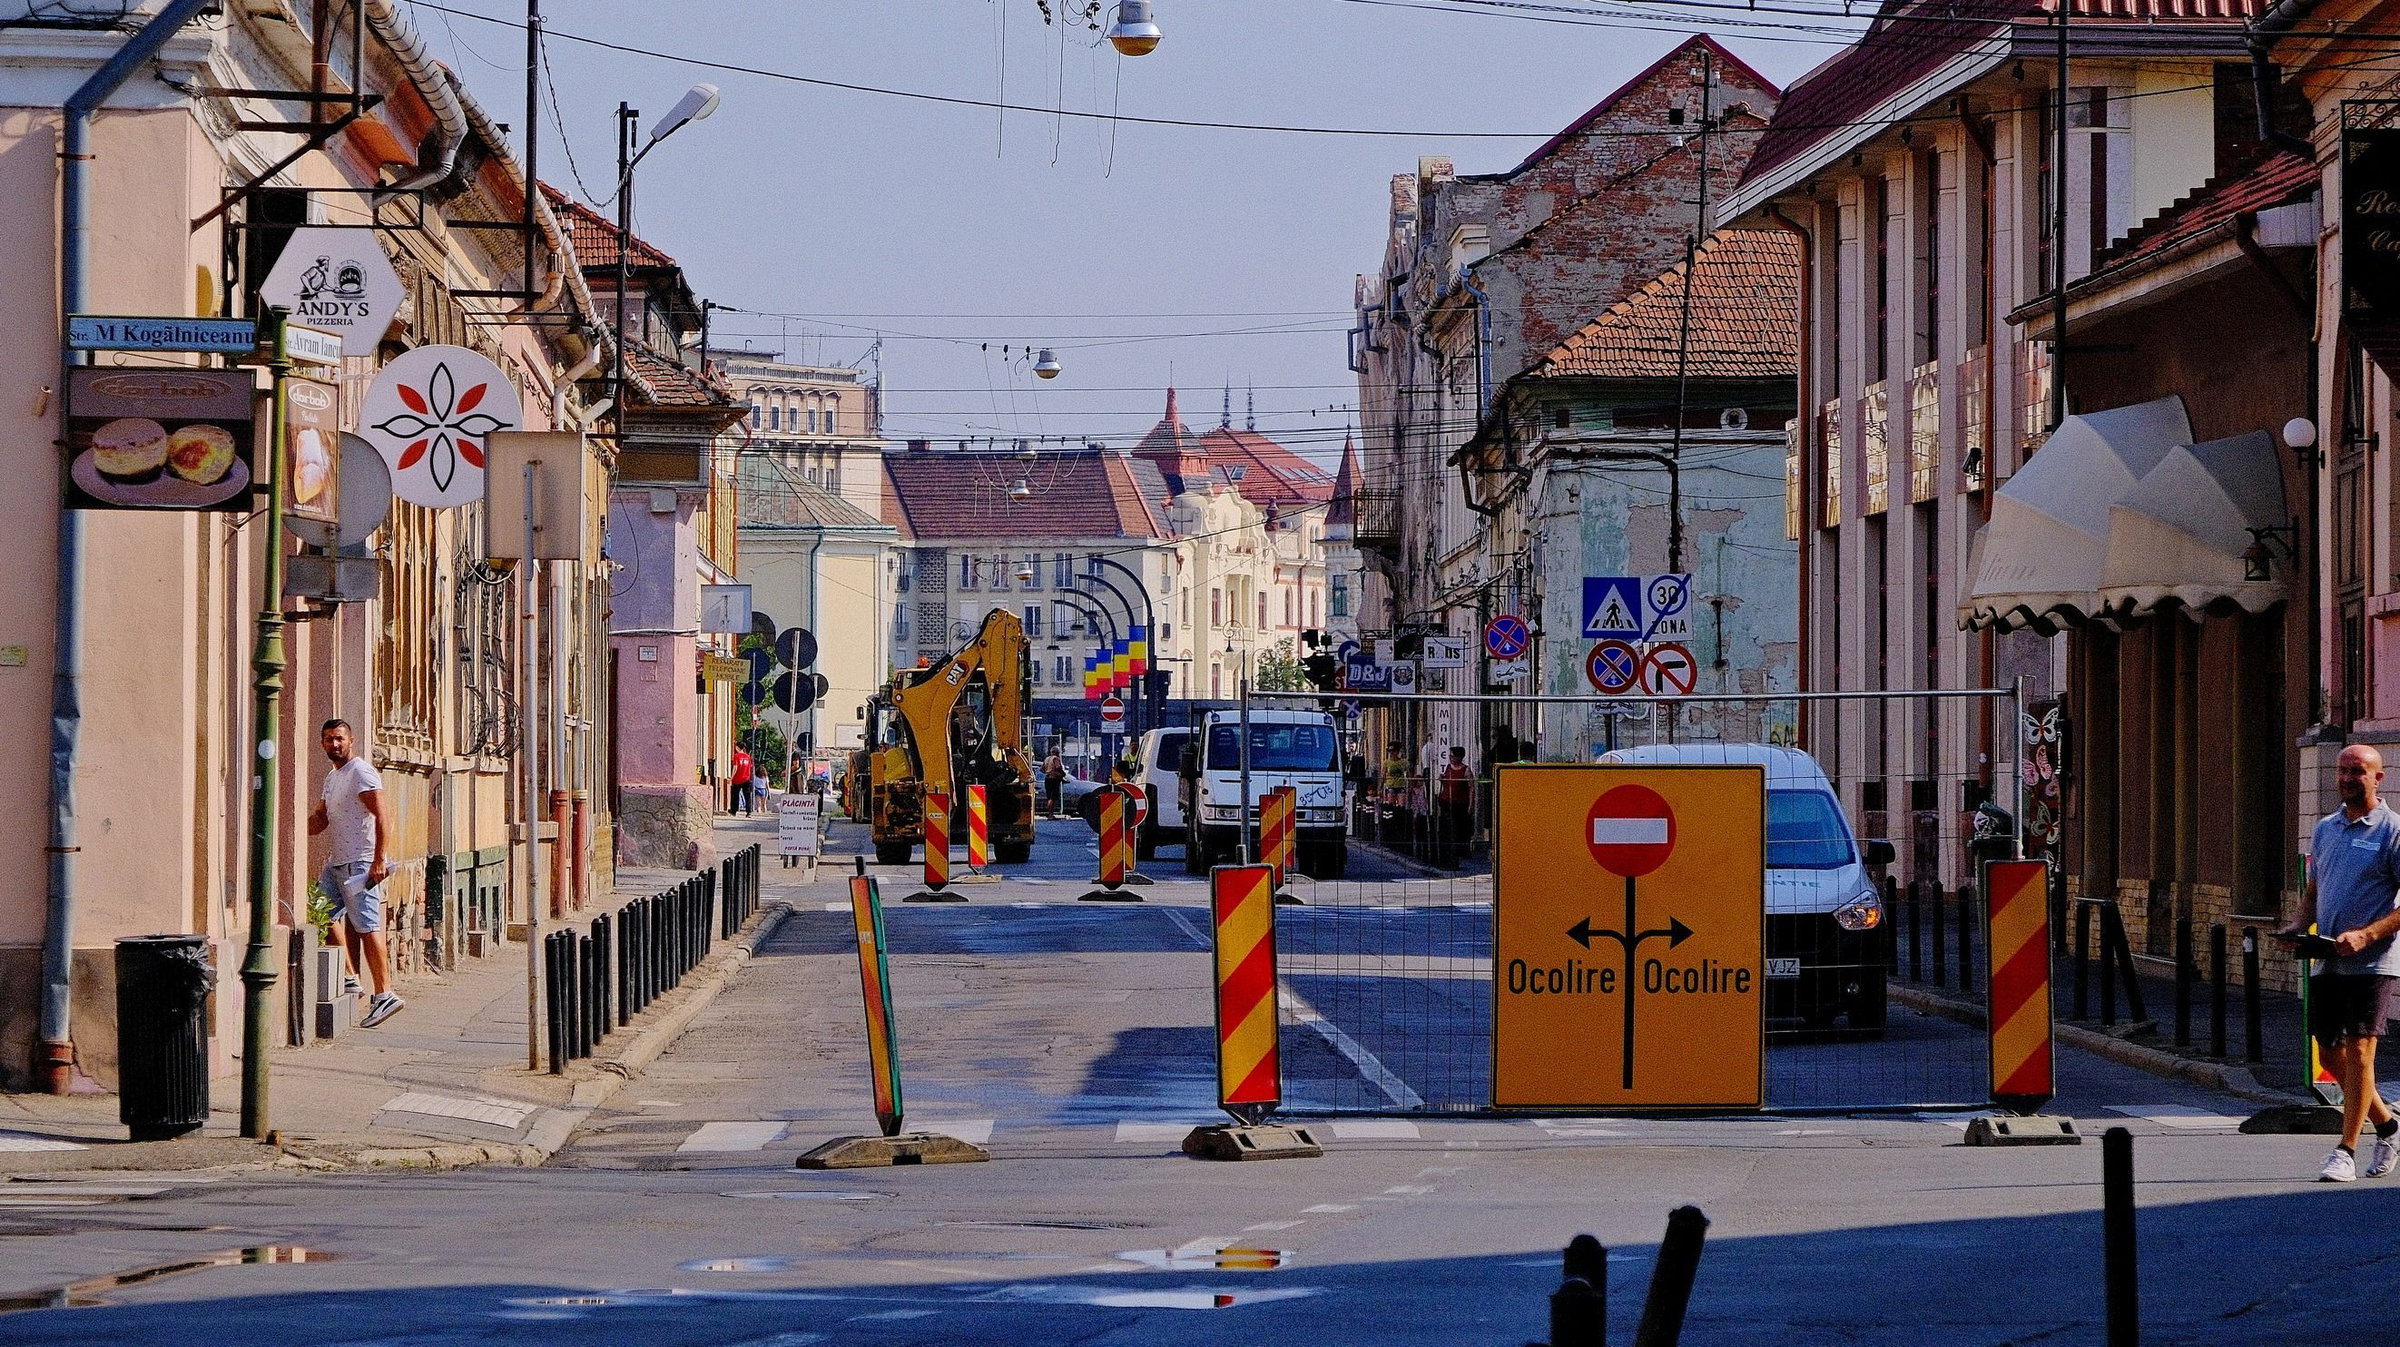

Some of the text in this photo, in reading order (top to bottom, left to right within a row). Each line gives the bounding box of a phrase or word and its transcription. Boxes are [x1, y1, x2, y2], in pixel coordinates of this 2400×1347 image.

[307, 318, 354, 326] PIZZERIA
[96, 325, 115, 342] M
[294, 332, 319, 355] Avram
[321, 336, 342, 359] Iancu
[1657, 585, 1678, 605] 30
[945, 663, 965, 687] CAT
[1349, 664, 1388, 685] D&J
[1508, 959, 1751, 994] Ocolire Ocolire
[1768, 960, 1797, 975] VJZ
